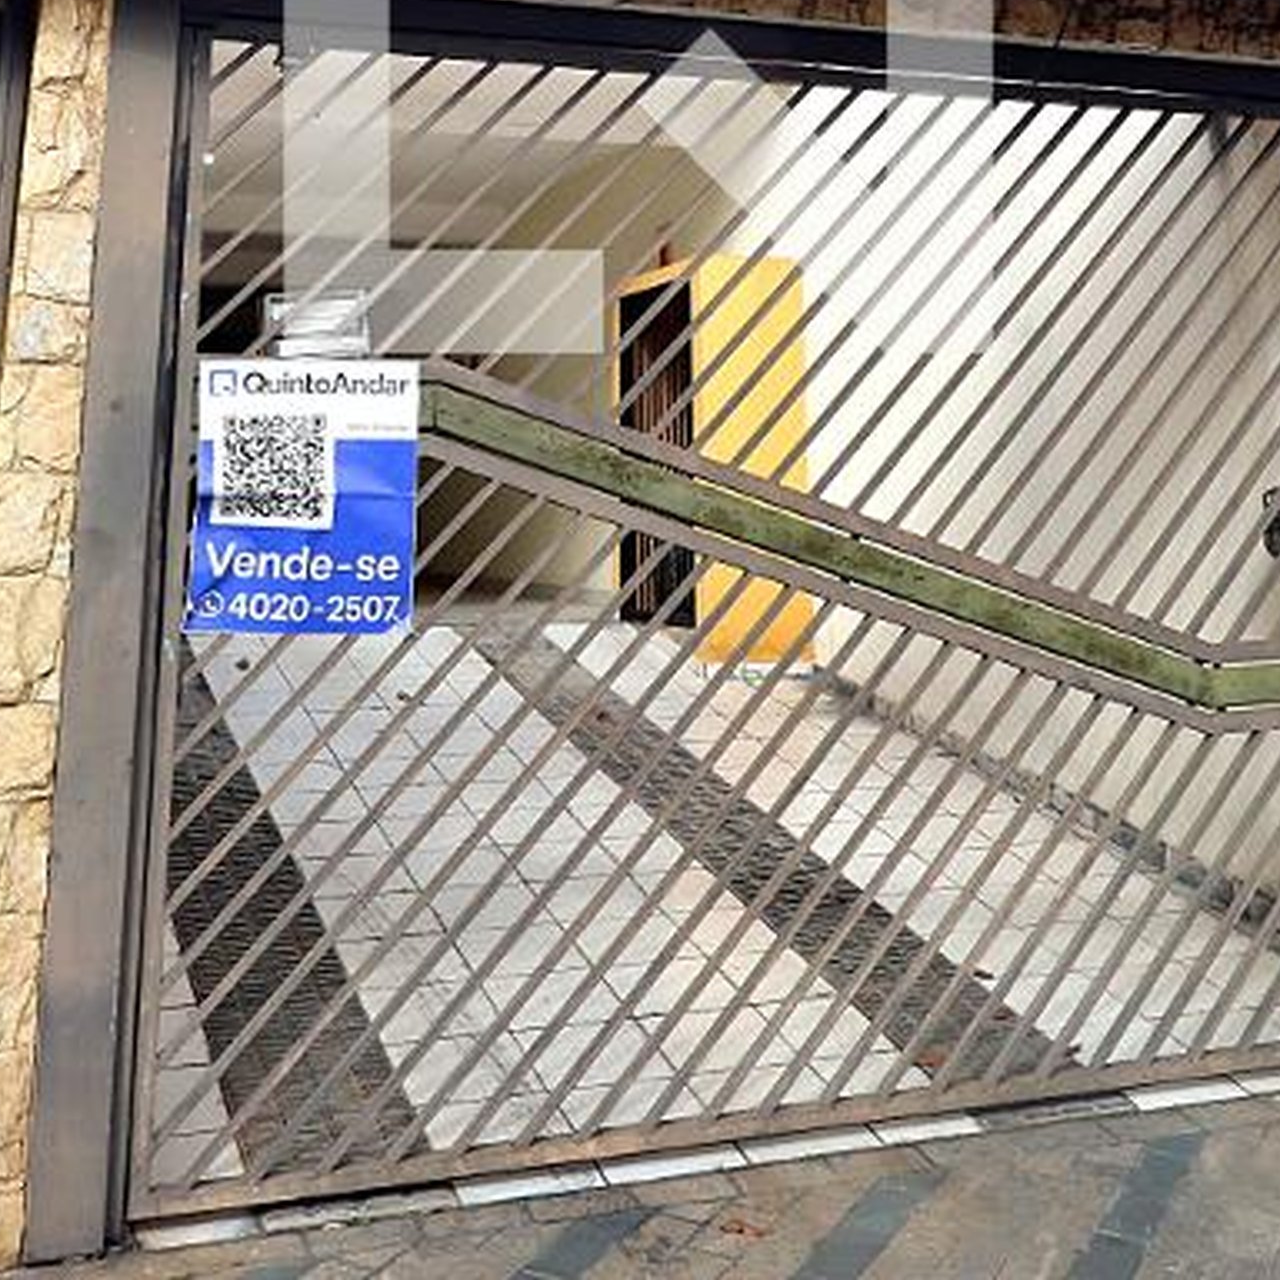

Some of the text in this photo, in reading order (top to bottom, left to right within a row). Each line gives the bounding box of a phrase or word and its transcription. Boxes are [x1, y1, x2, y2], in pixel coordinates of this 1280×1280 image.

[242, 371, 410, 396] QuintoAndar
[206, 542, 401, 582] Vende-se
[228, 592, 402, 622] 4020-2507
